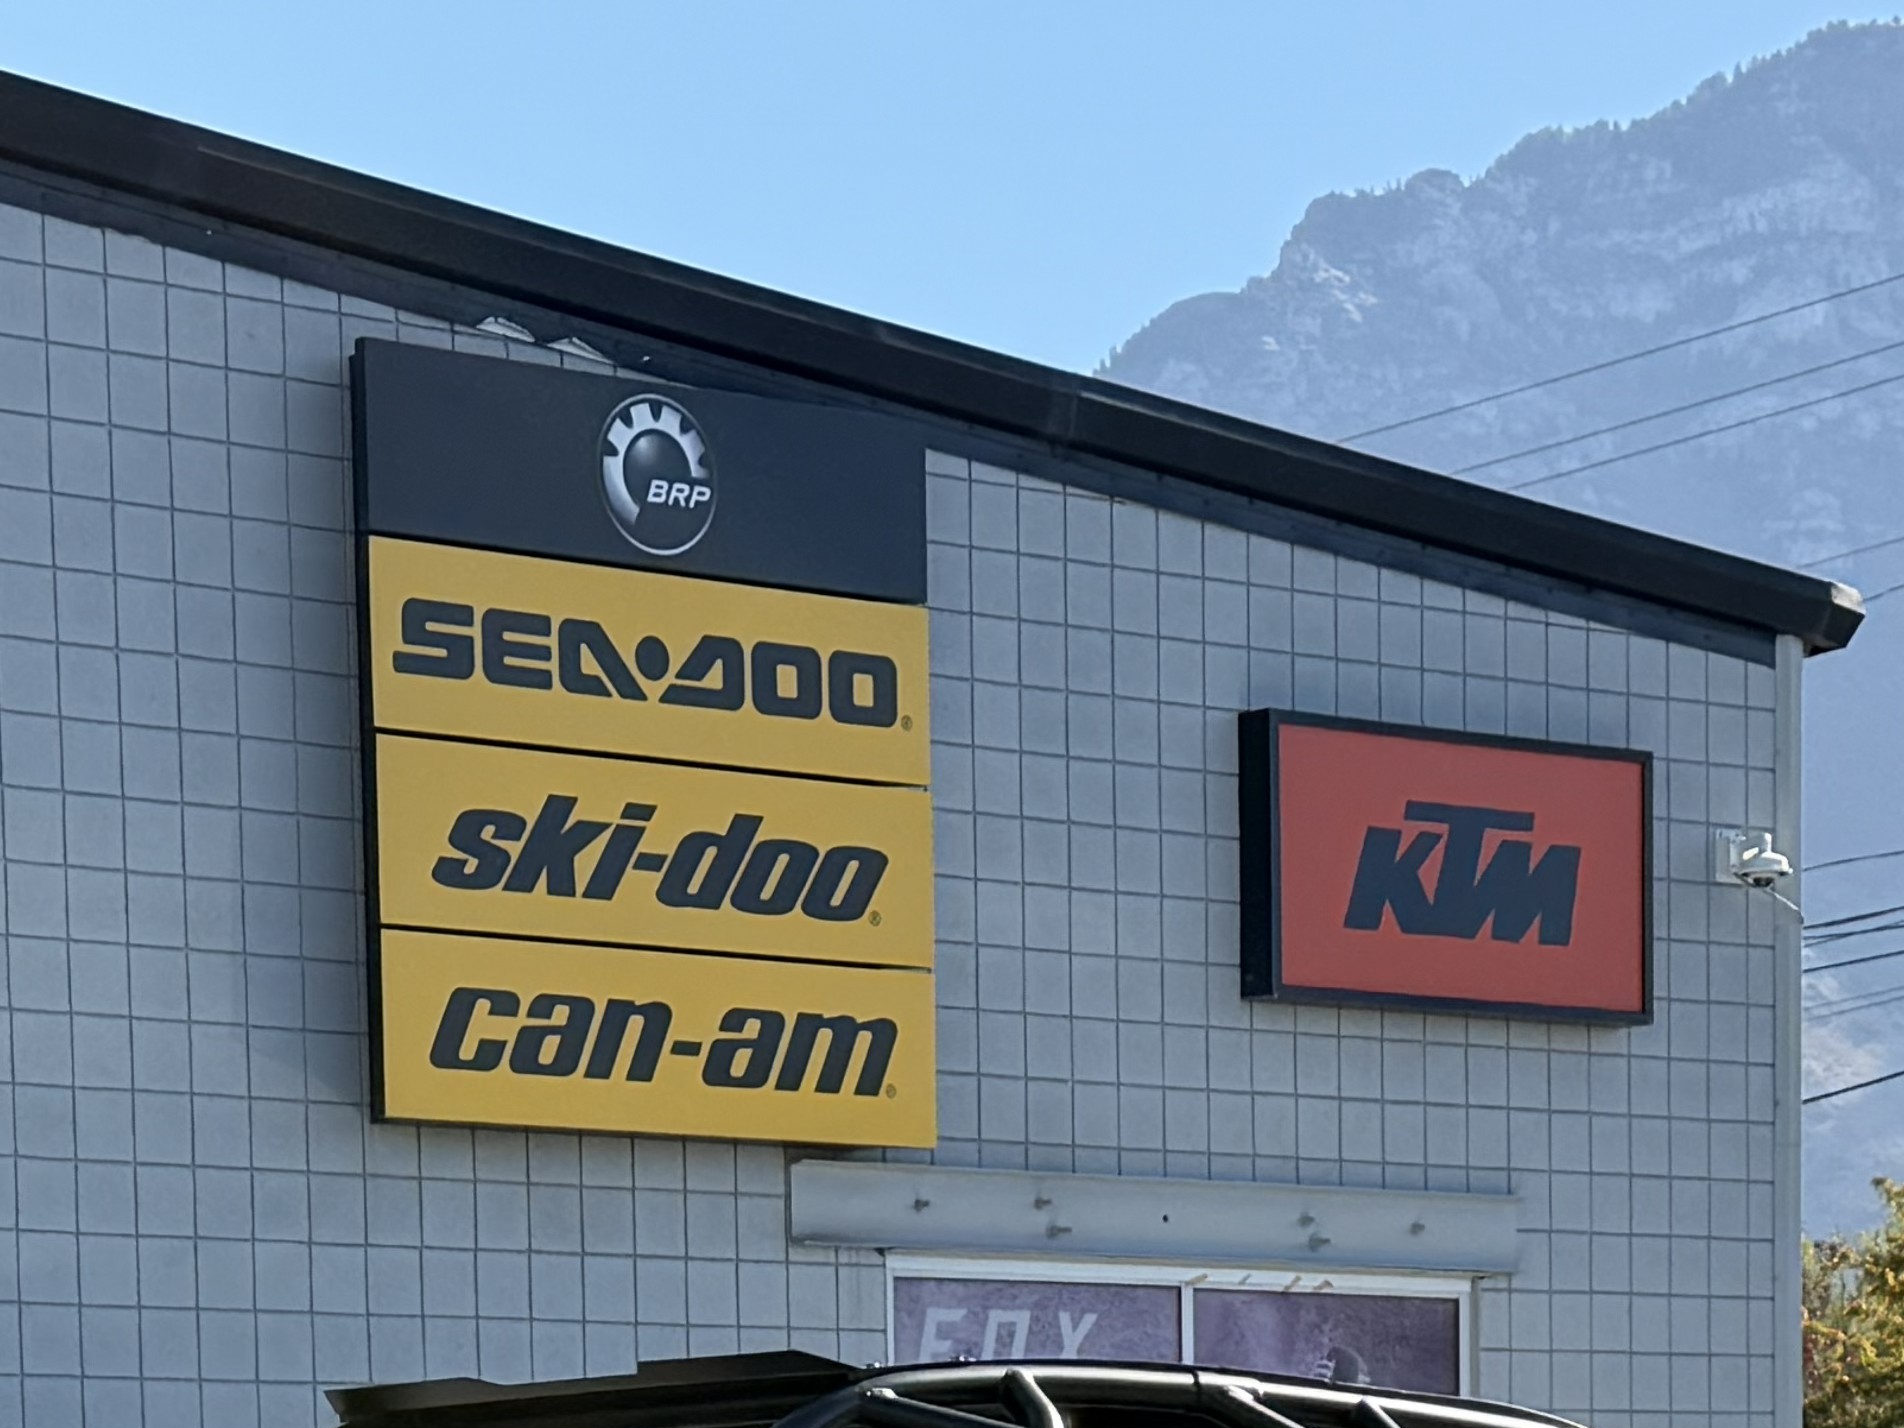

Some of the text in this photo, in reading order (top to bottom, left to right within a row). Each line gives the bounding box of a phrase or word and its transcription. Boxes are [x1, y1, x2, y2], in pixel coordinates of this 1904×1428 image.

[646, 478, 712, 510] BRP
[1342, 799, 1582, 947] KTM
[917, 1306, 1098, 1363] FOX
